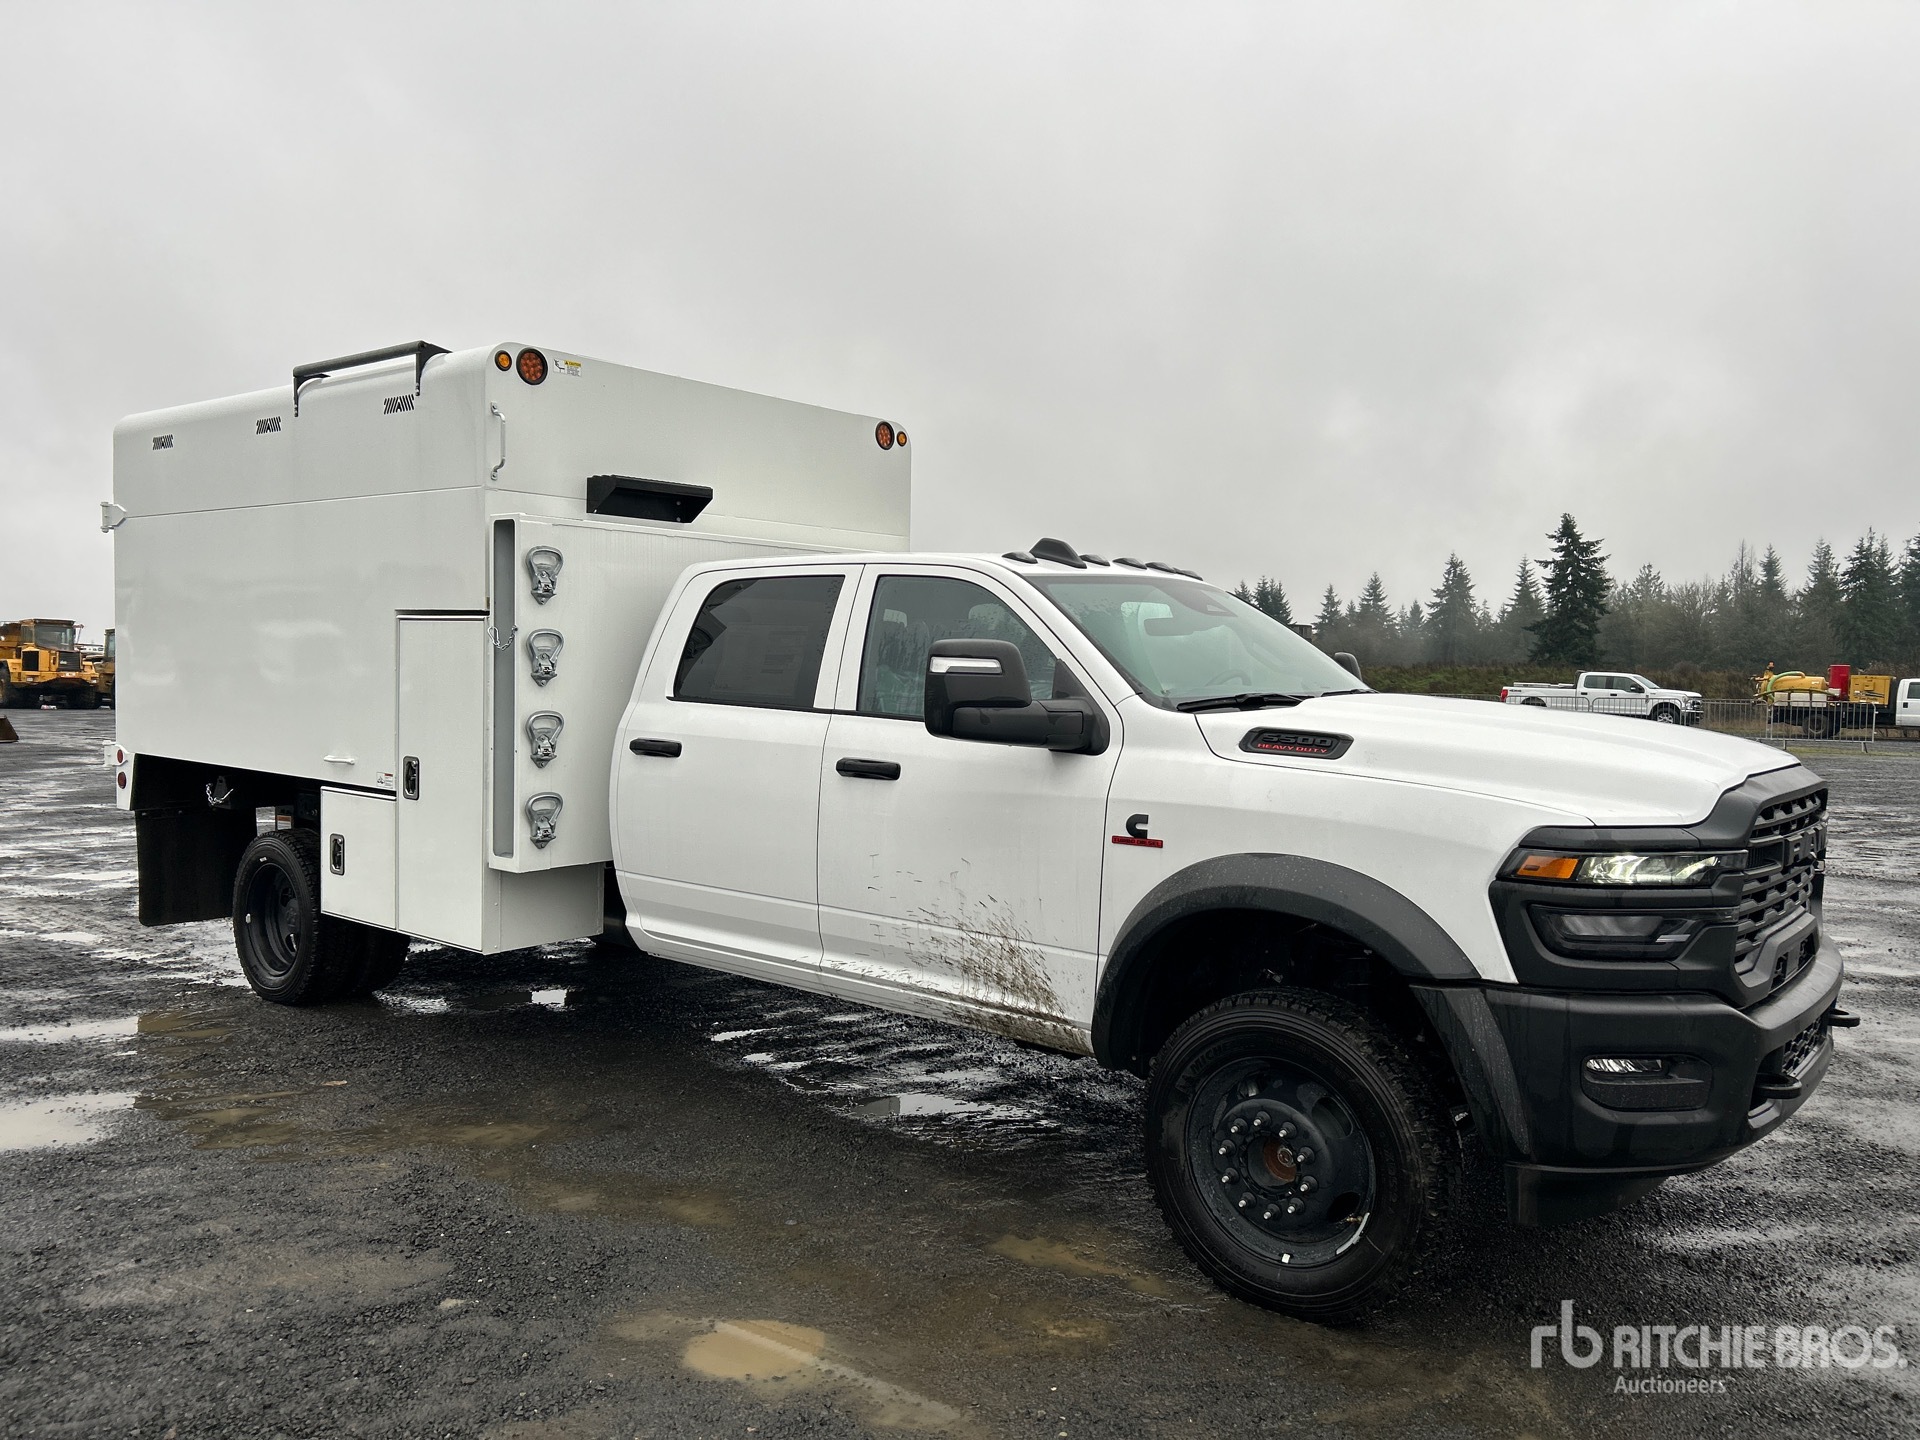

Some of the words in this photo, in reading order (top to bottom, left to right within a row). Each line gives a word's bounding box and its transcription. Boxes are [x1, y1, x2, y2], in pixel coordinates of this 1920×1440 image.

[1262, 733, 1332, 748] 5500
[1257, 743, 1295, 751] HEAVY
[1296, 745, 1328, 754] DUTY
[1113, 837, 1135, 845] TURBO
[1137, 839, 1162, 847] DIESEL
